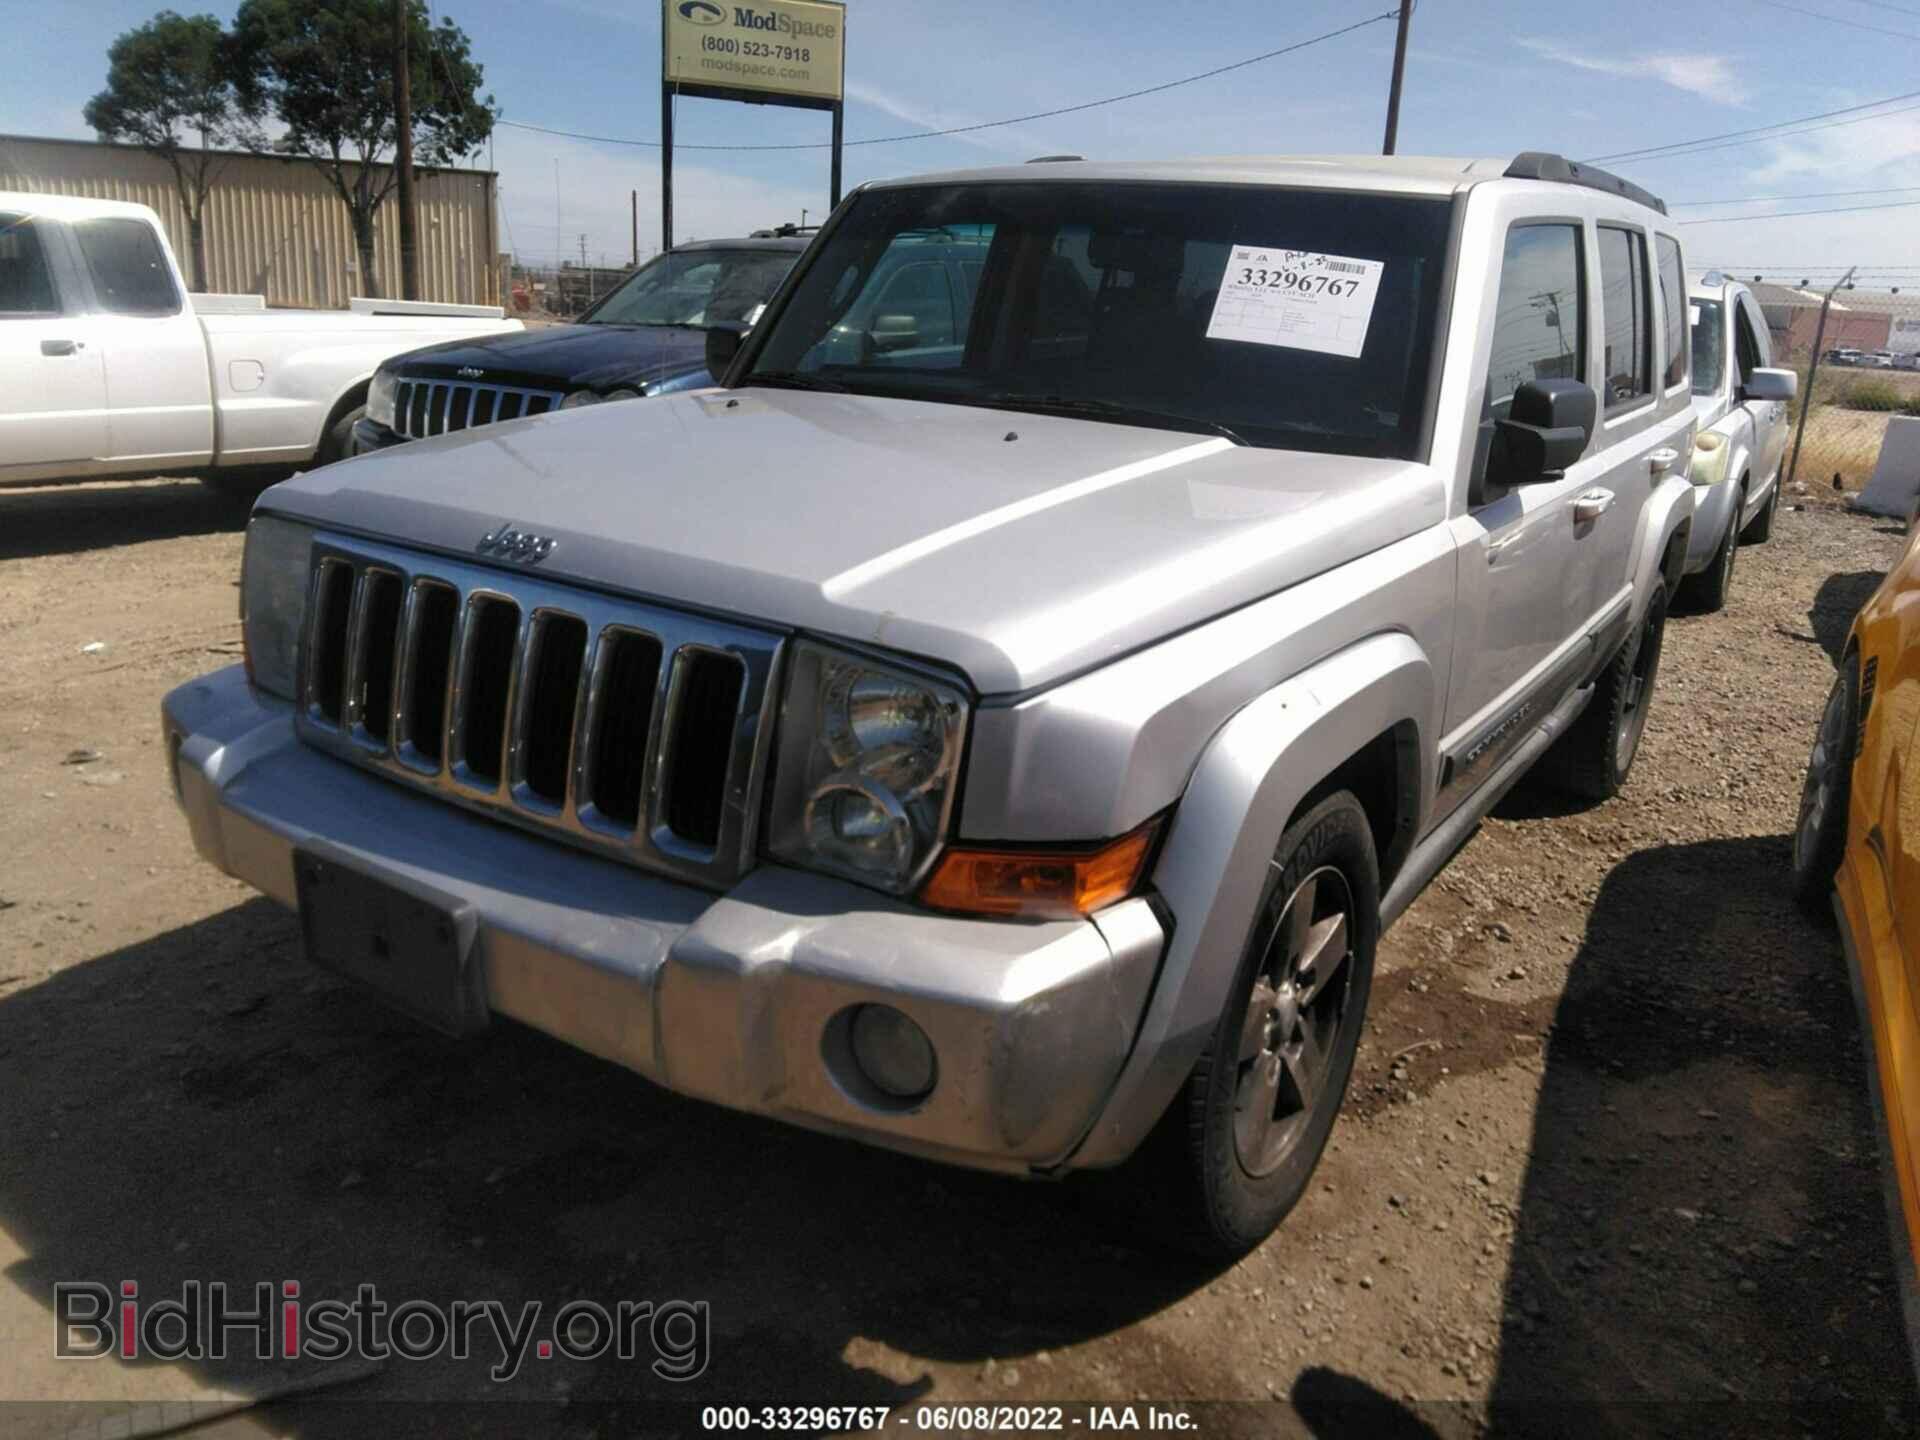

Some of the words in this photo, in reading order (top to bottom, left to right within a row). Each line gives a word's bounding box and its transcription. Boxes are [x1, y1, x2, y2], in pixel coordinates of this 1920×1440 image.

[733, 7, 836, 40] ModSpace
[701, 34, 740, 56] (800)
[743, 42, 811, 63] 523-7918
[701, 57, 810, 81] modspace.com
[1237, 267, 1360, 299] 33296767
[475, 521, 559, 567] Jeep
